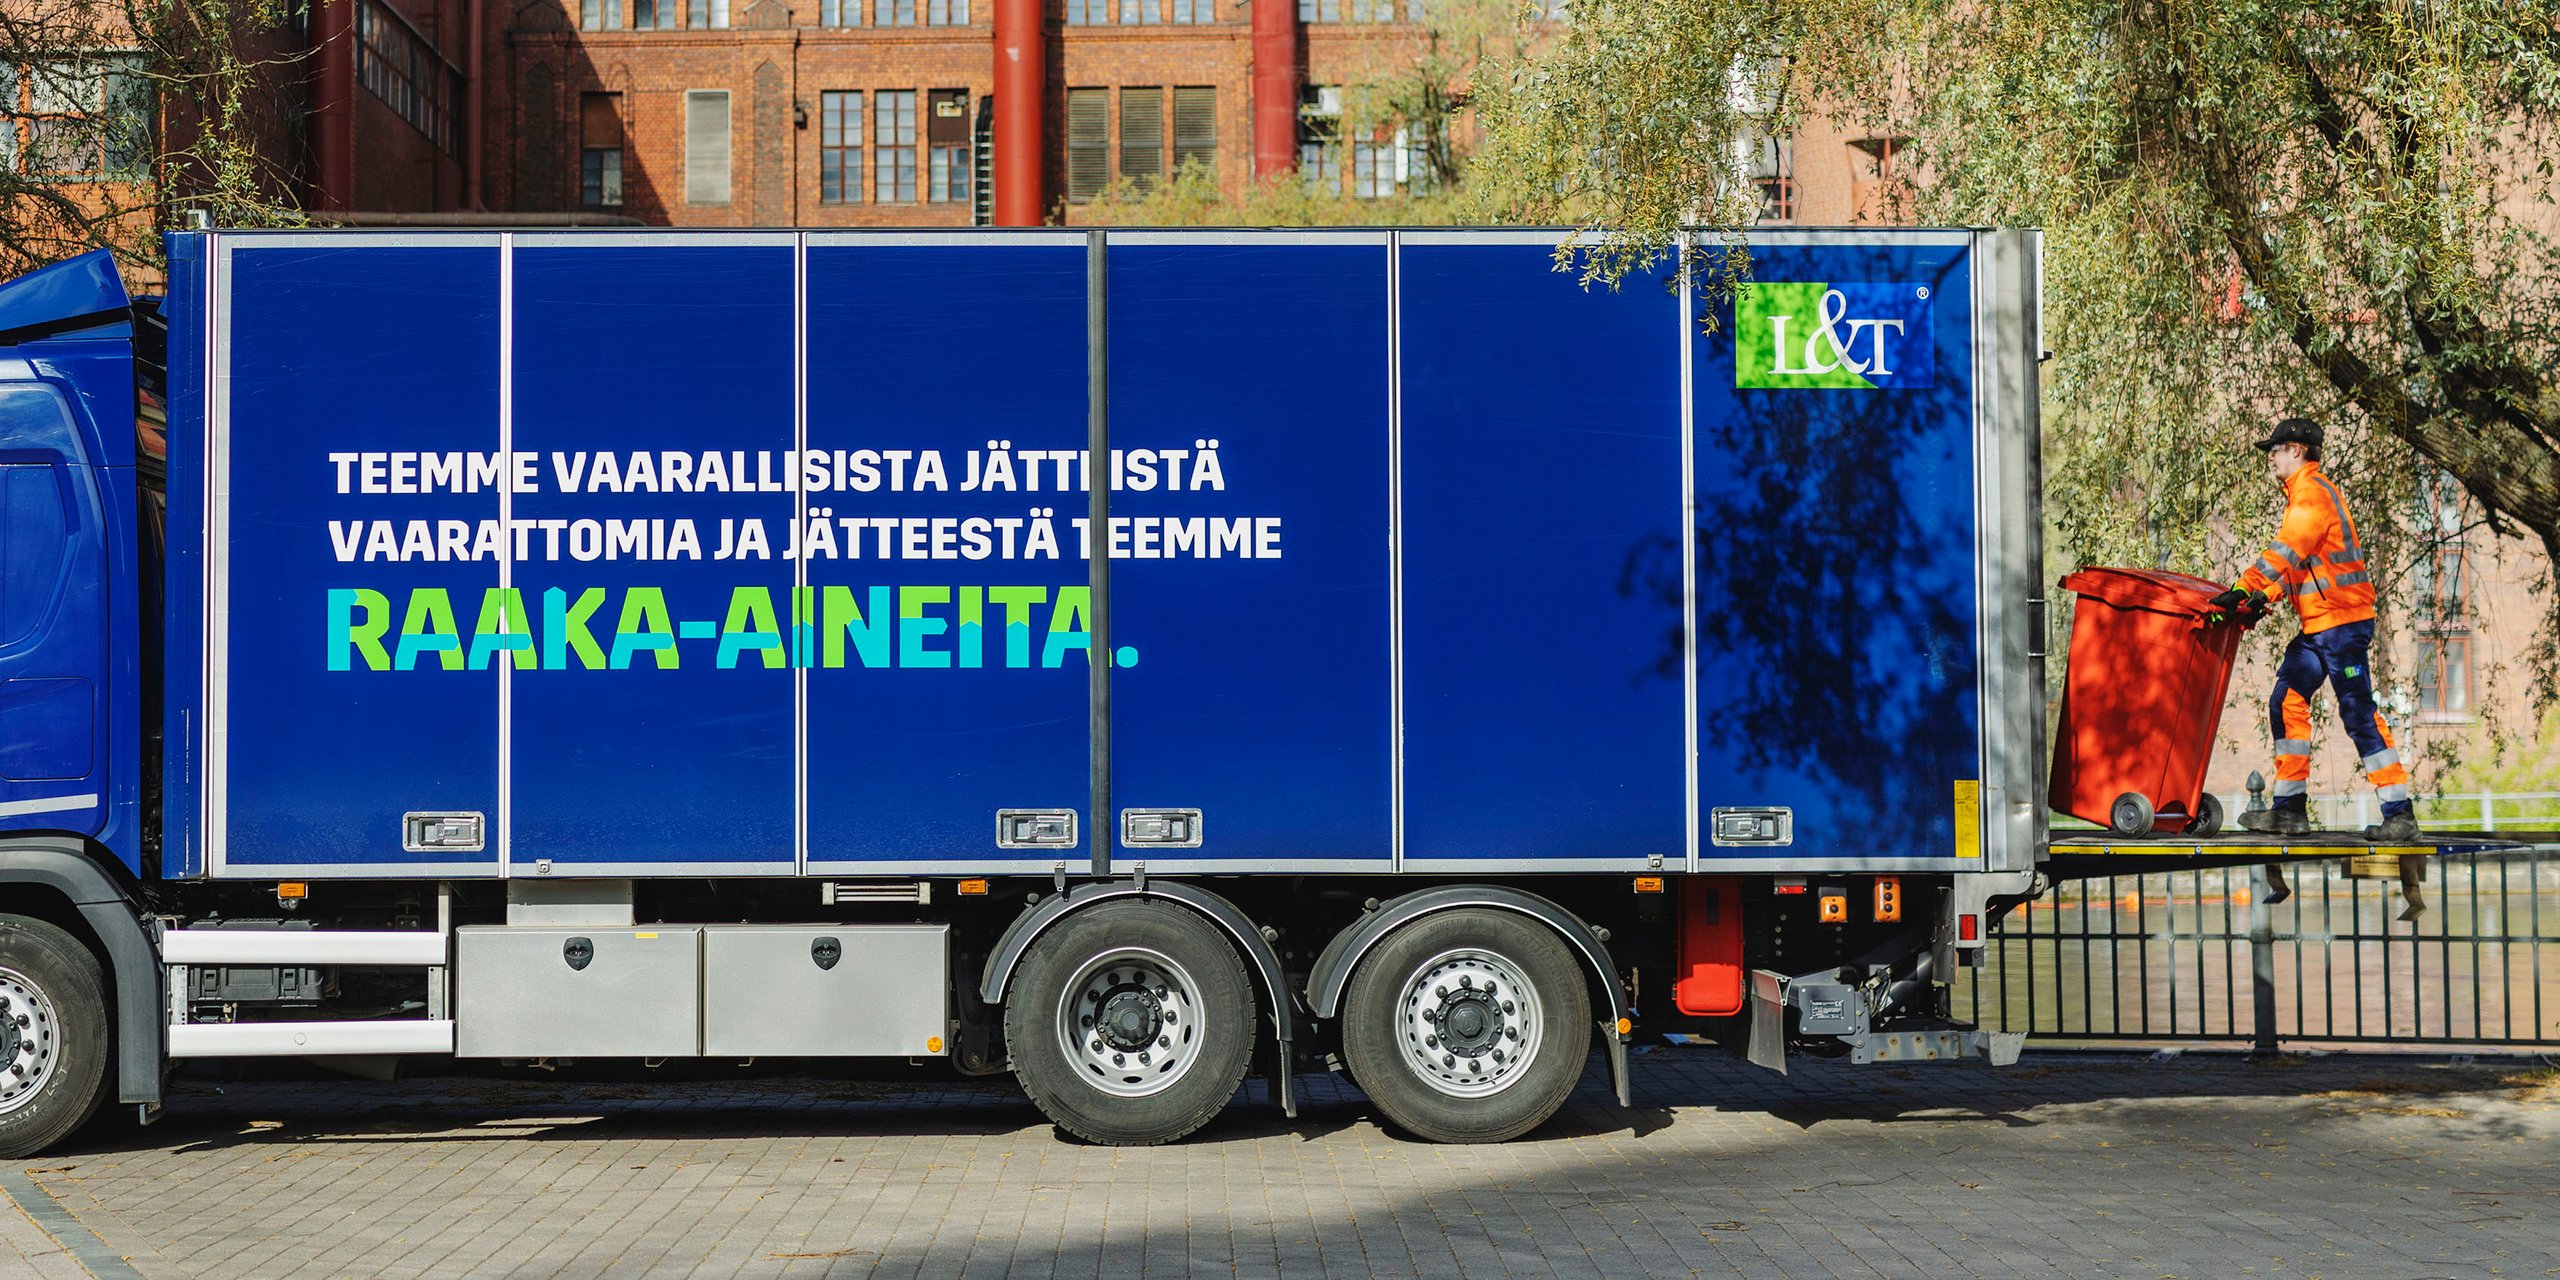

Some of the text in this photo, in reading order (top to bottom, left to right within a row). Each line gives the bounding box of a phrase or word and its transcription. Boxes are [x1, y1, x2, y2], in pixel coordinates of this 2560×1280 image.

[1767, 289, 1904, 375] L&T
[328, 452, 539, 494] TEEMME
[552, 450, 948, 493] VAARALLISISTA
[328, 507, 1282, 562] VAARATTOMIA JA JÄTTEESTÄ TEEMME
[327, 585, 1139, 671] RAAKA-AINEITA.
